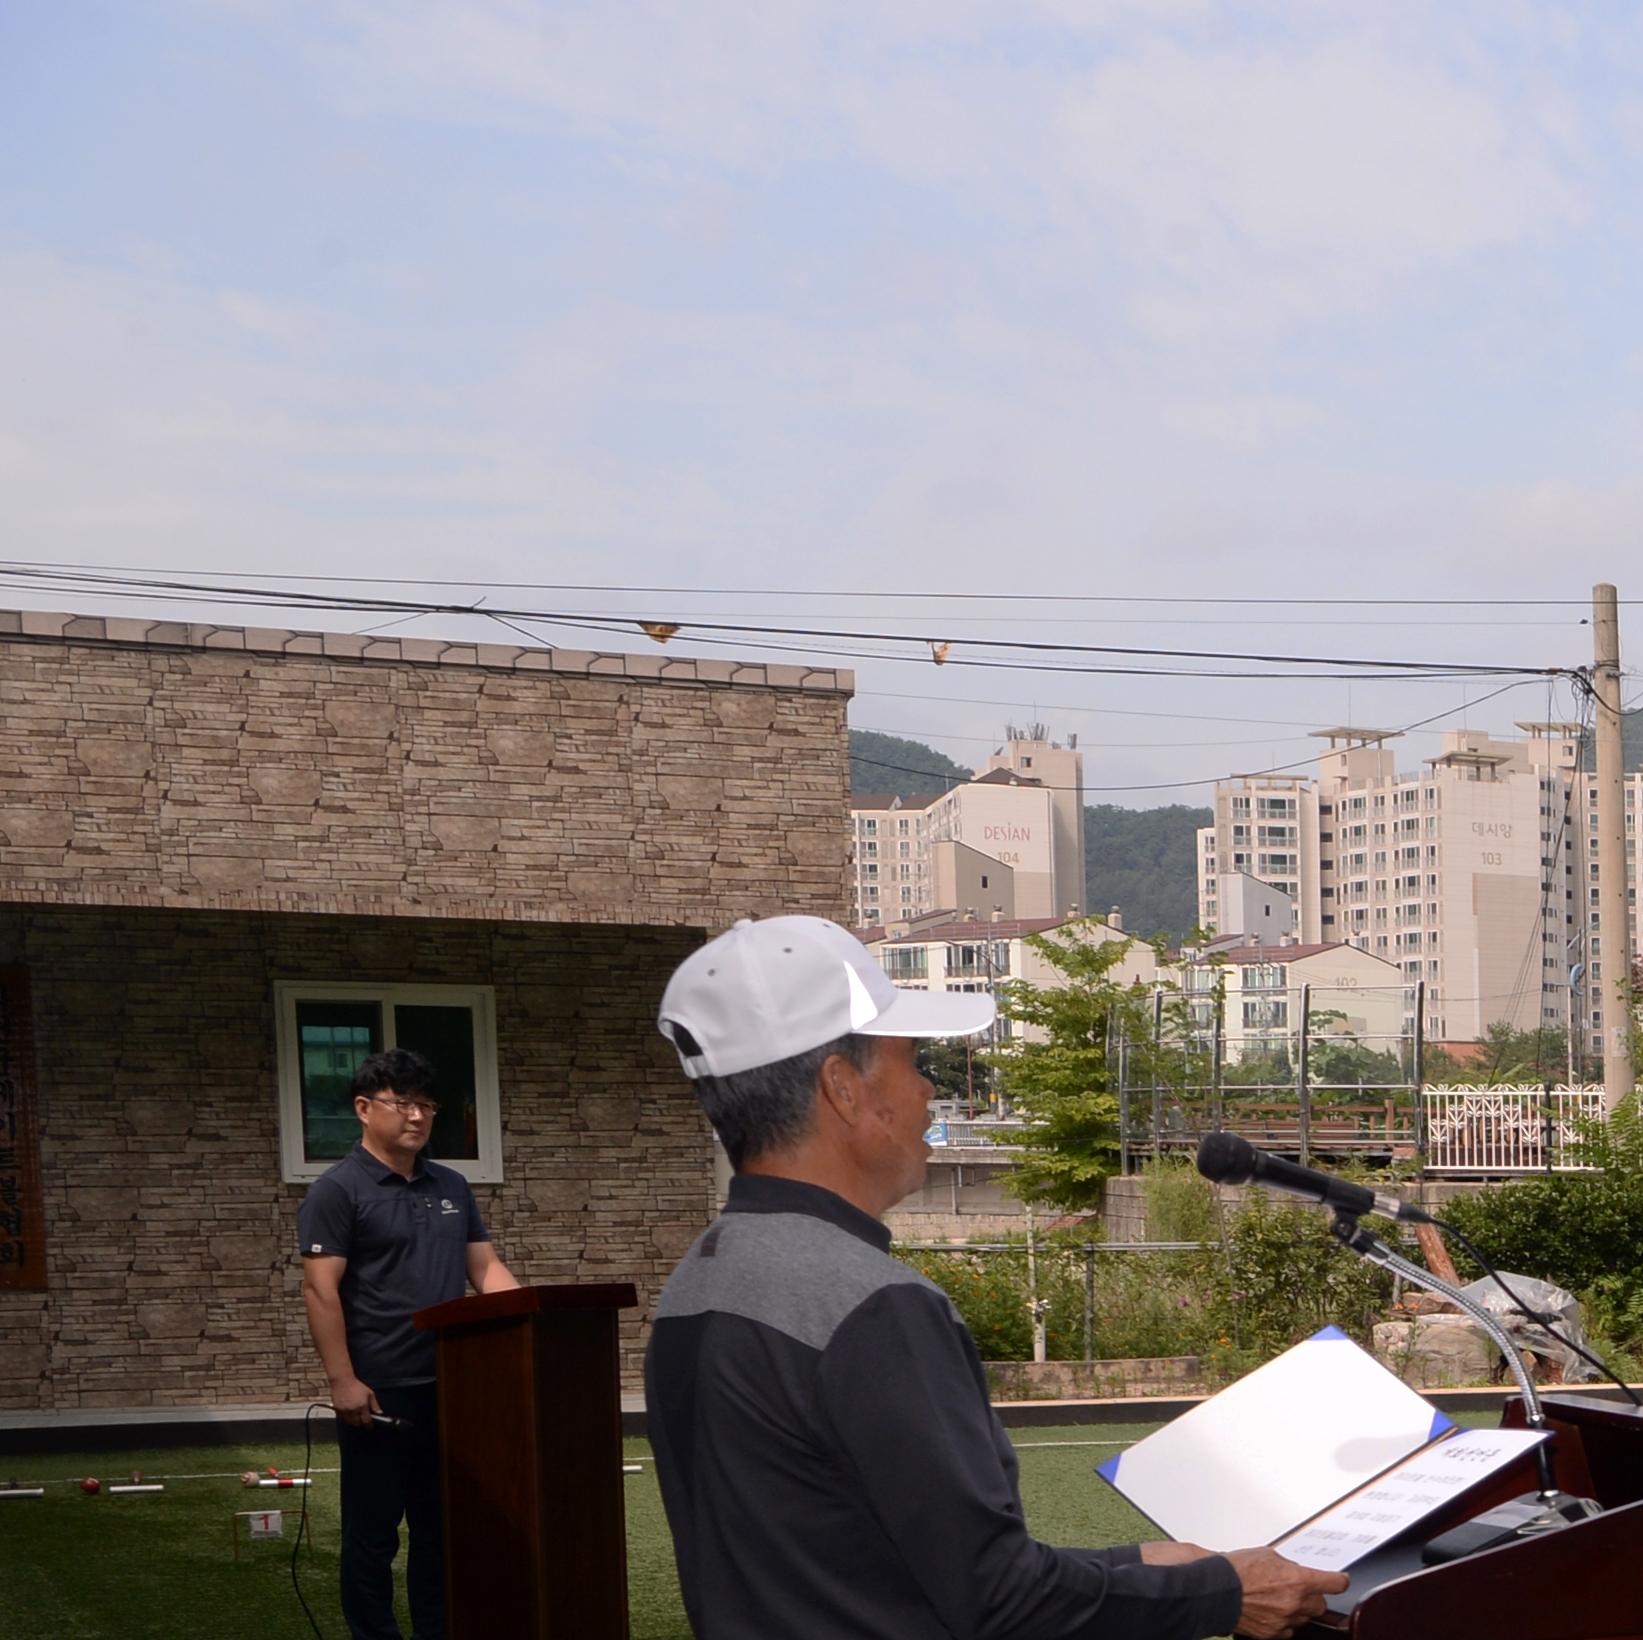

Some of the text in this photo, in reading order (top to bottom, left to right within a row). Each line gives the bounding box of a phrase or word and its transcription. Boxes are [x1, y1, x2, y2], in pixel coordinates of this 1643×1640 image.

[1471, 822, 1512, 838] 데시앙
[998, 852, 1020, 863] 104
[1481, 852, 1502, 865] 103
[258, 1514, 269, 1530] 1
